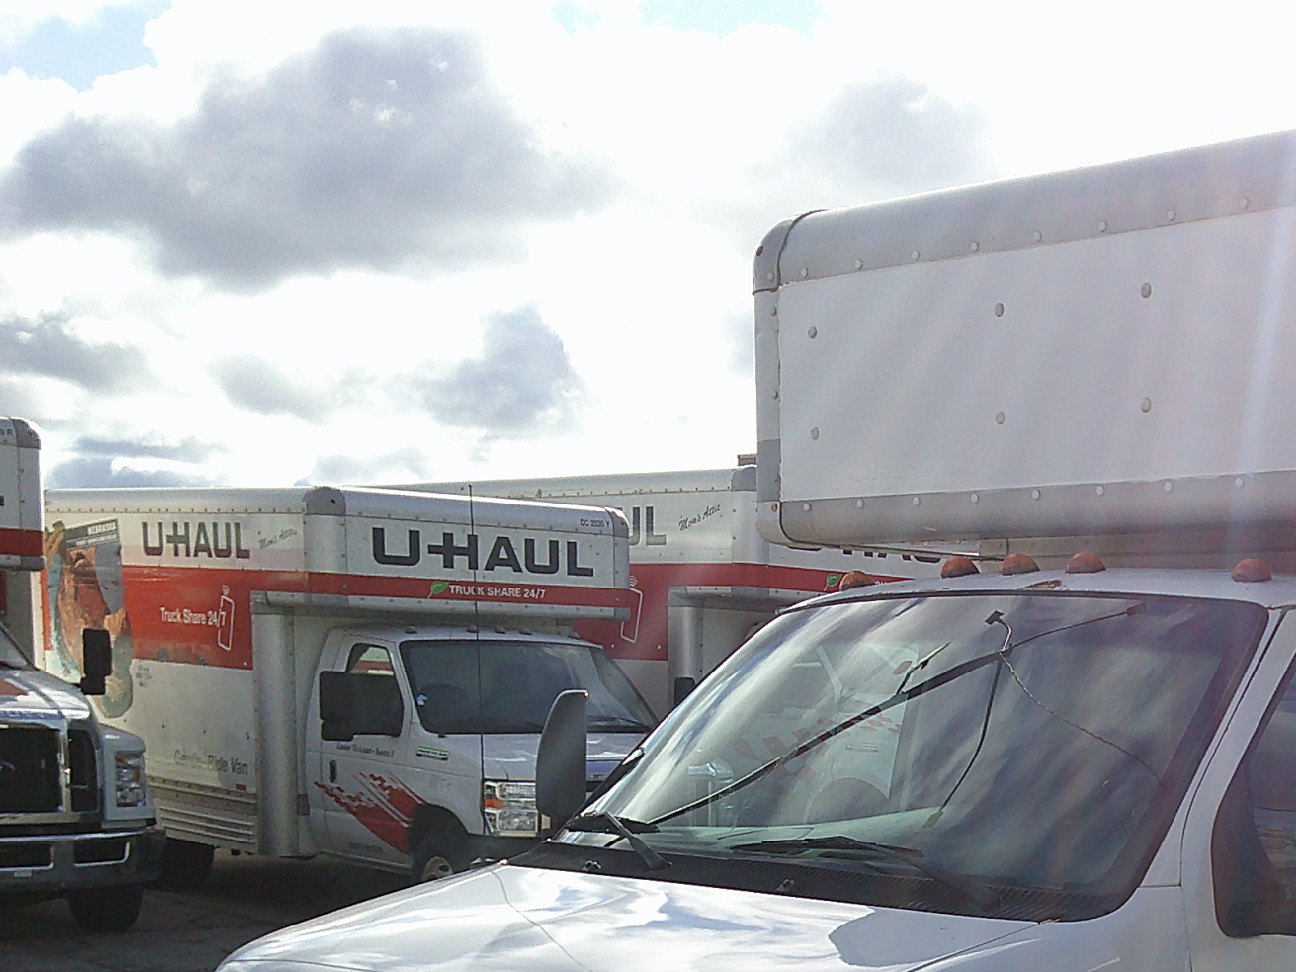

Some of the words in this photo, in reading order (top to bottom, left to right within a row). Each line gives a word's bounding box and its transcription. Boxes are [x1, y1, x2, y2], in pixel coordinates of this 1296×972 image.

[142, 521, 250, 559] U-HAUL
[372, 527, 594, 577] U-HAUL
[449, 585, 485, 596] TRUCK
[487, 586, 521, 598] SHARE
[523, 588, 546, 600] 24/7
[160, 606, 182, 623] Truck
[183, 608, 207, 625] Share
[208, 609, 226, 628] 24/7
